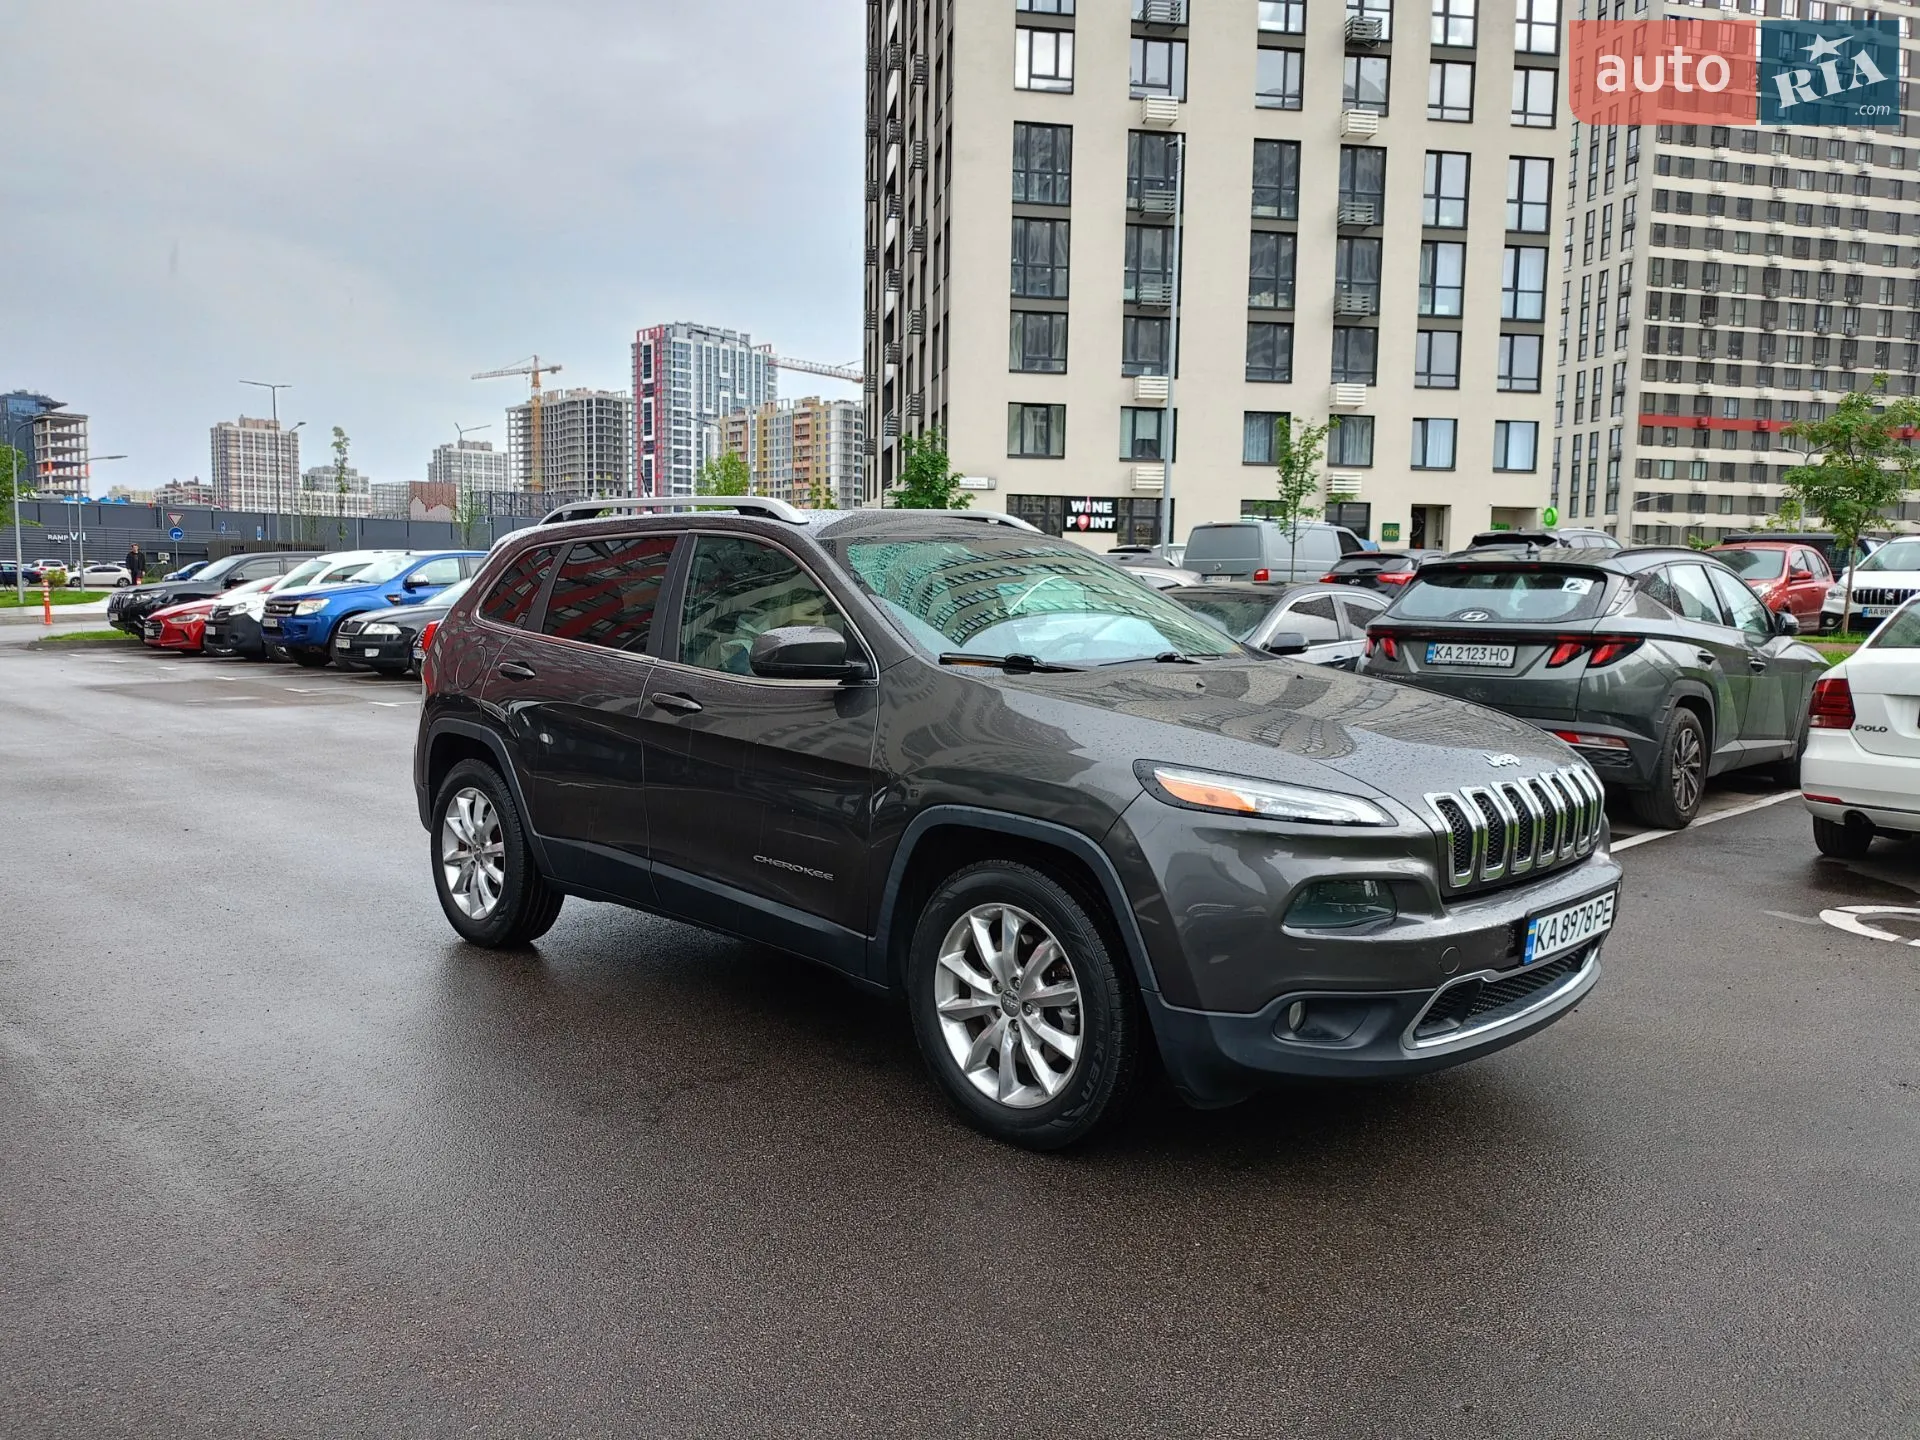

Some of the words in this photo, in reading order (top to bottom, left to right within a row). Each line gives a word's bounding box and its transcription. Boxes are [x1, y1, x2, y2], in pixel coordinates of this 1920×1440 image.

[1070, 497, 1113, 513] WINE
[1066, 514, 1116, 530] POINT
[1435, 645, 1453, 659] KA
[1455, 646, 1487, 660] 2123
[1489, 647, 1510, 661] HO
[1855, 724, 1888, 733] POLO
[753, 855, 834, 881] CHEROKEE
